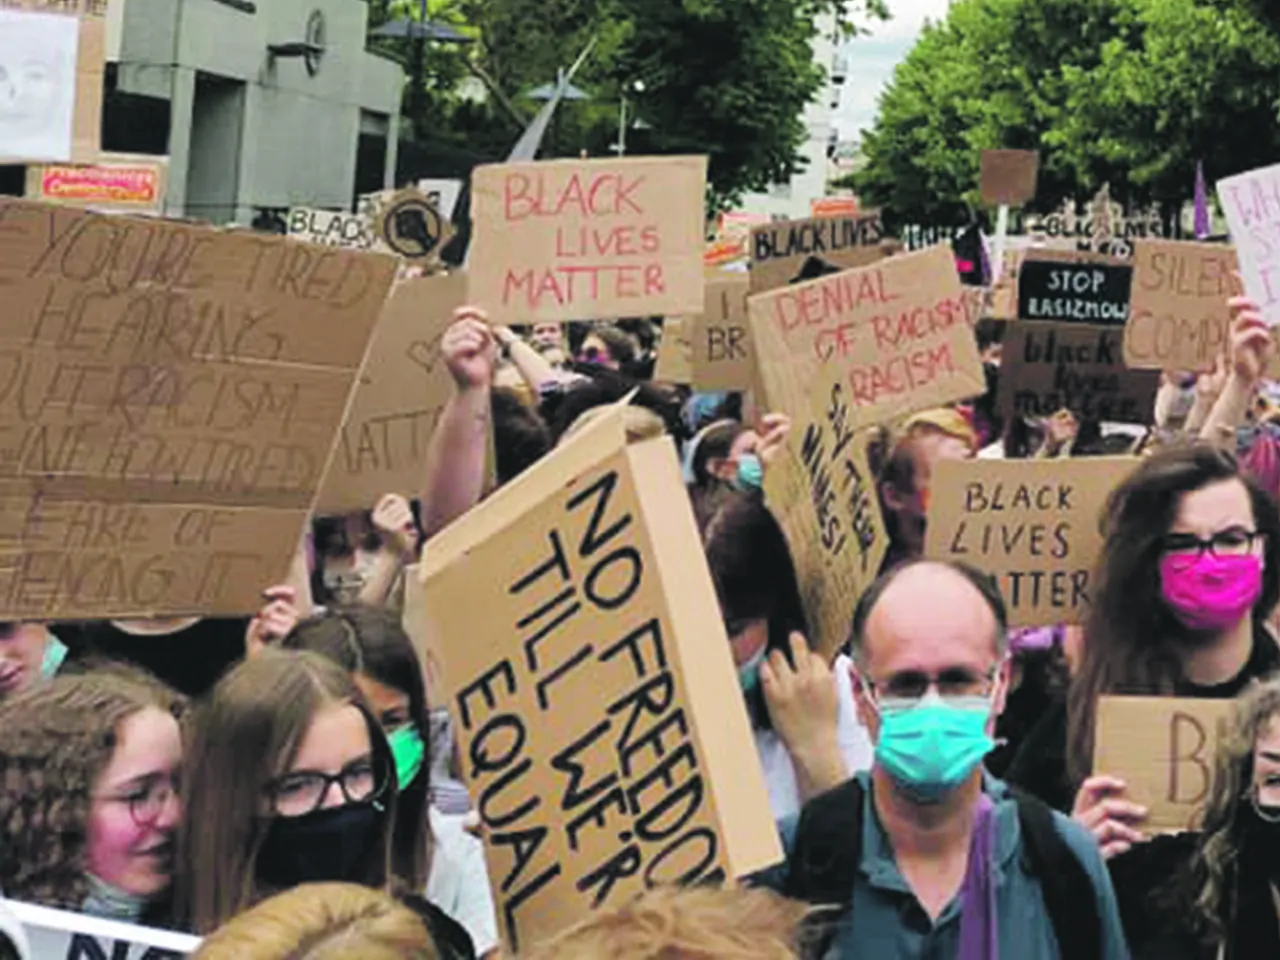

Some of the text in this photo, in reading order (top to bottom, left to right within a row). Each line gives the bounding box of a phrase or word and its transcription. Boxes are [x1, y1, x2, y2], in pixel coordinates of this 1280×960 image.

[504, 171, 648, 222] BLACK
[556, 226, 660, 258] LIVES
[755, 223, 826, 261] BLACK
[830, 214, 883, 249] LIVES
[246, 240, 376, 310] TIRED
[503, 265, 666, 307] MATTER
[773, 267, 900, 332] DENIAL
[1047, 270, 1105, 294] STOP
[28, 286, 286, 363] HEARING
[813, 321, 861, 364] OF
[872, 292, 976, 351] RACISM
[1024, 330, 1113, 364] black
[849, 349, 954, 407] RACISM
[965, 482, 1074, 513] BLACK
[566, 471, 643, 610] NO
[950, 522, 1071, 558] LIVES
[990, 569, 1093, 609] TTER
[509, 528, 595, 711] TILL
[456, 659, 561, 953] EQUAL
